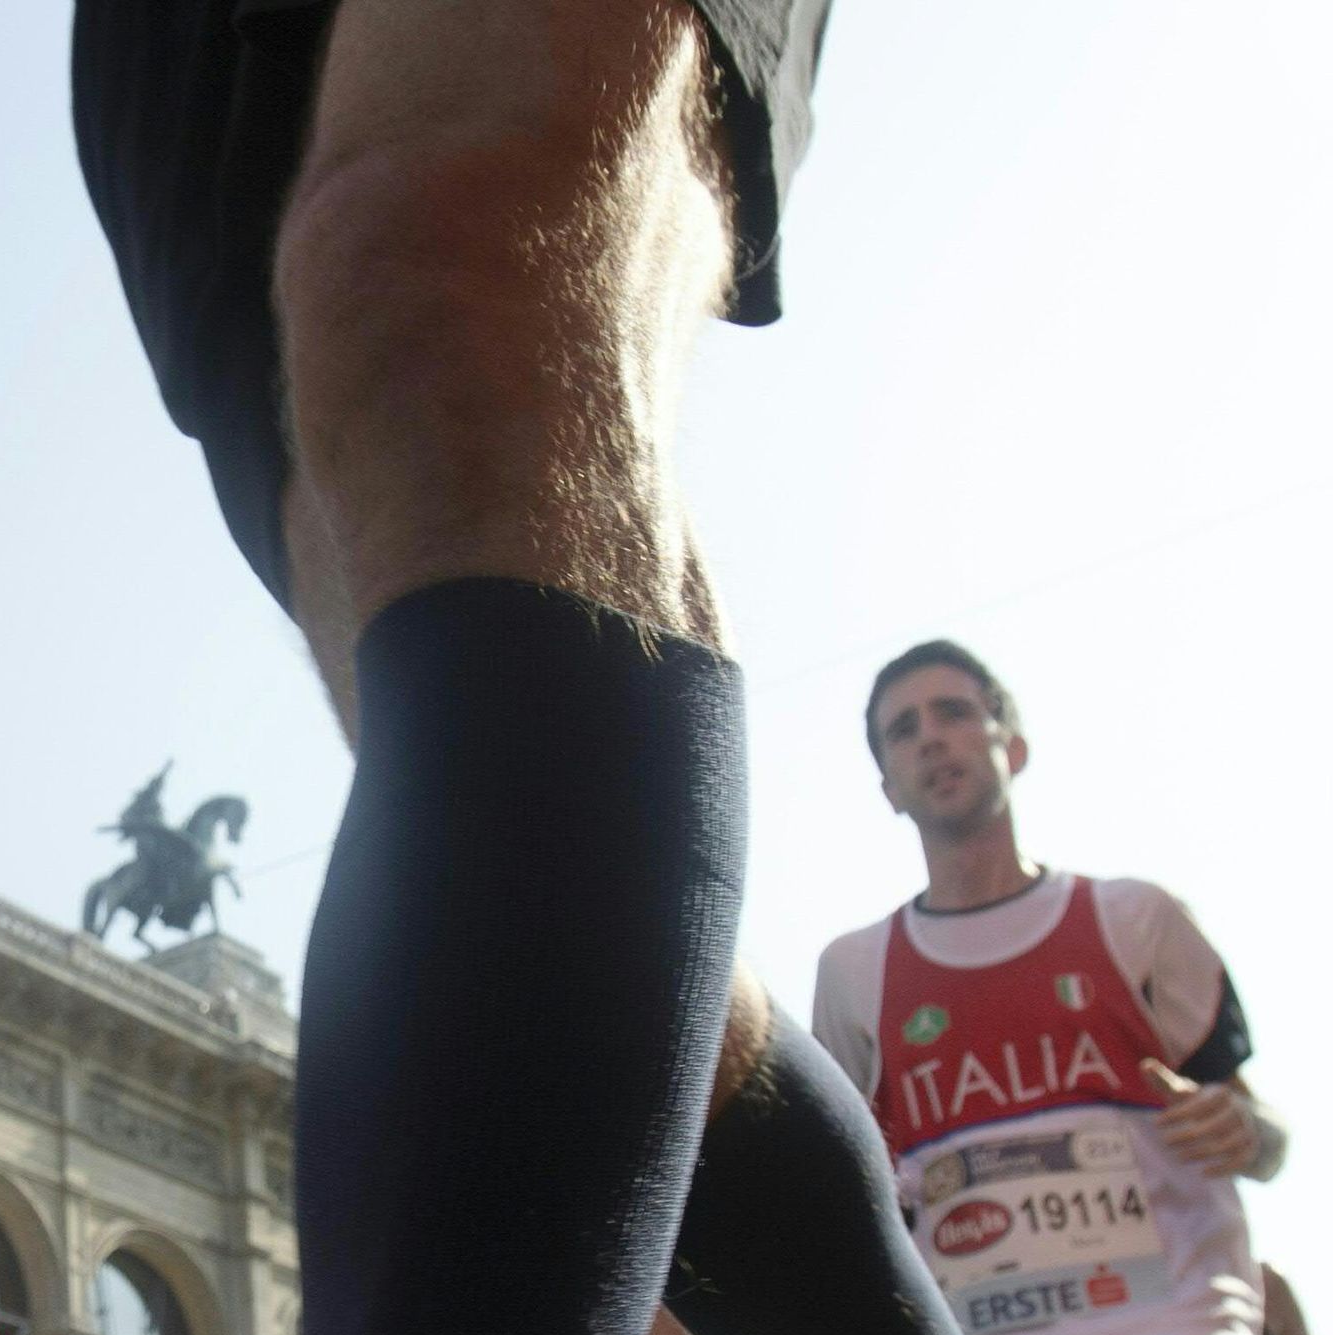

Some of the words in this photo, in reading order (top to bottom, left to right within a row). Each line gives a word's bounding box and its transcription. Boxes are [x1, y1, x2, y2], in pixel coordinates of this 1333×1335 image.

[900, 1029, 1123, 1131] ITALIA
[1020, 1183, 1147, 1234] 19114
[968, 1279, 1083, 1330] ERSTE
